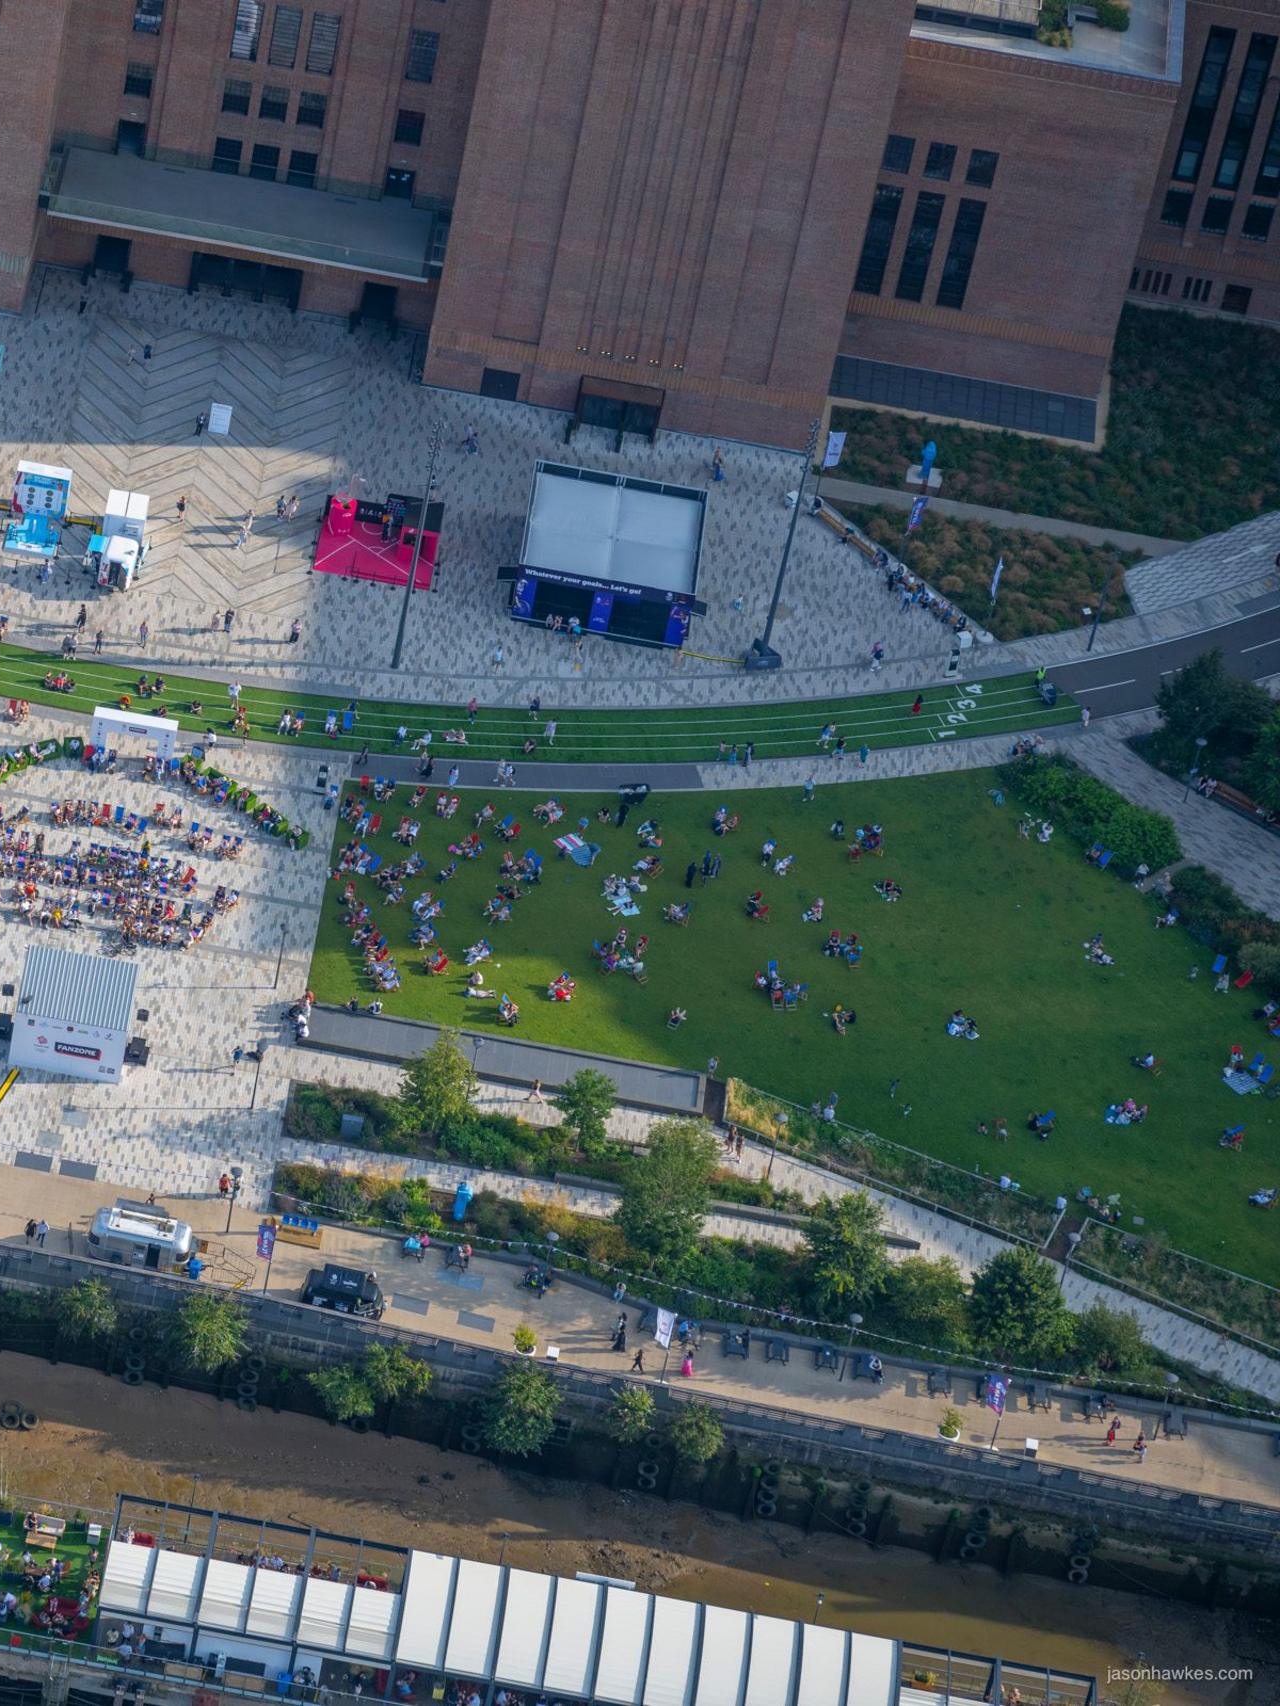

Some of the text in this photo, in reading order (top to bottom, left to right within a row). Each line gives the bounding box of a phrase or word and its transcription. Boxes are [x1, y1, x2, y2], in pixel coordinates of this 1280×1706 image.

[525, 568, 561, 580] Whatever
[563, 576, 581, 584] your
[610, 584, 627, 592] Let's
[965, 684, 982, 694] 4
[957, 699, 976, 709] 3
[947, 713, 967, 723] 2
[937, 730, 956, 738] 1
[57, 1044, 97, 1056] FANZONE
